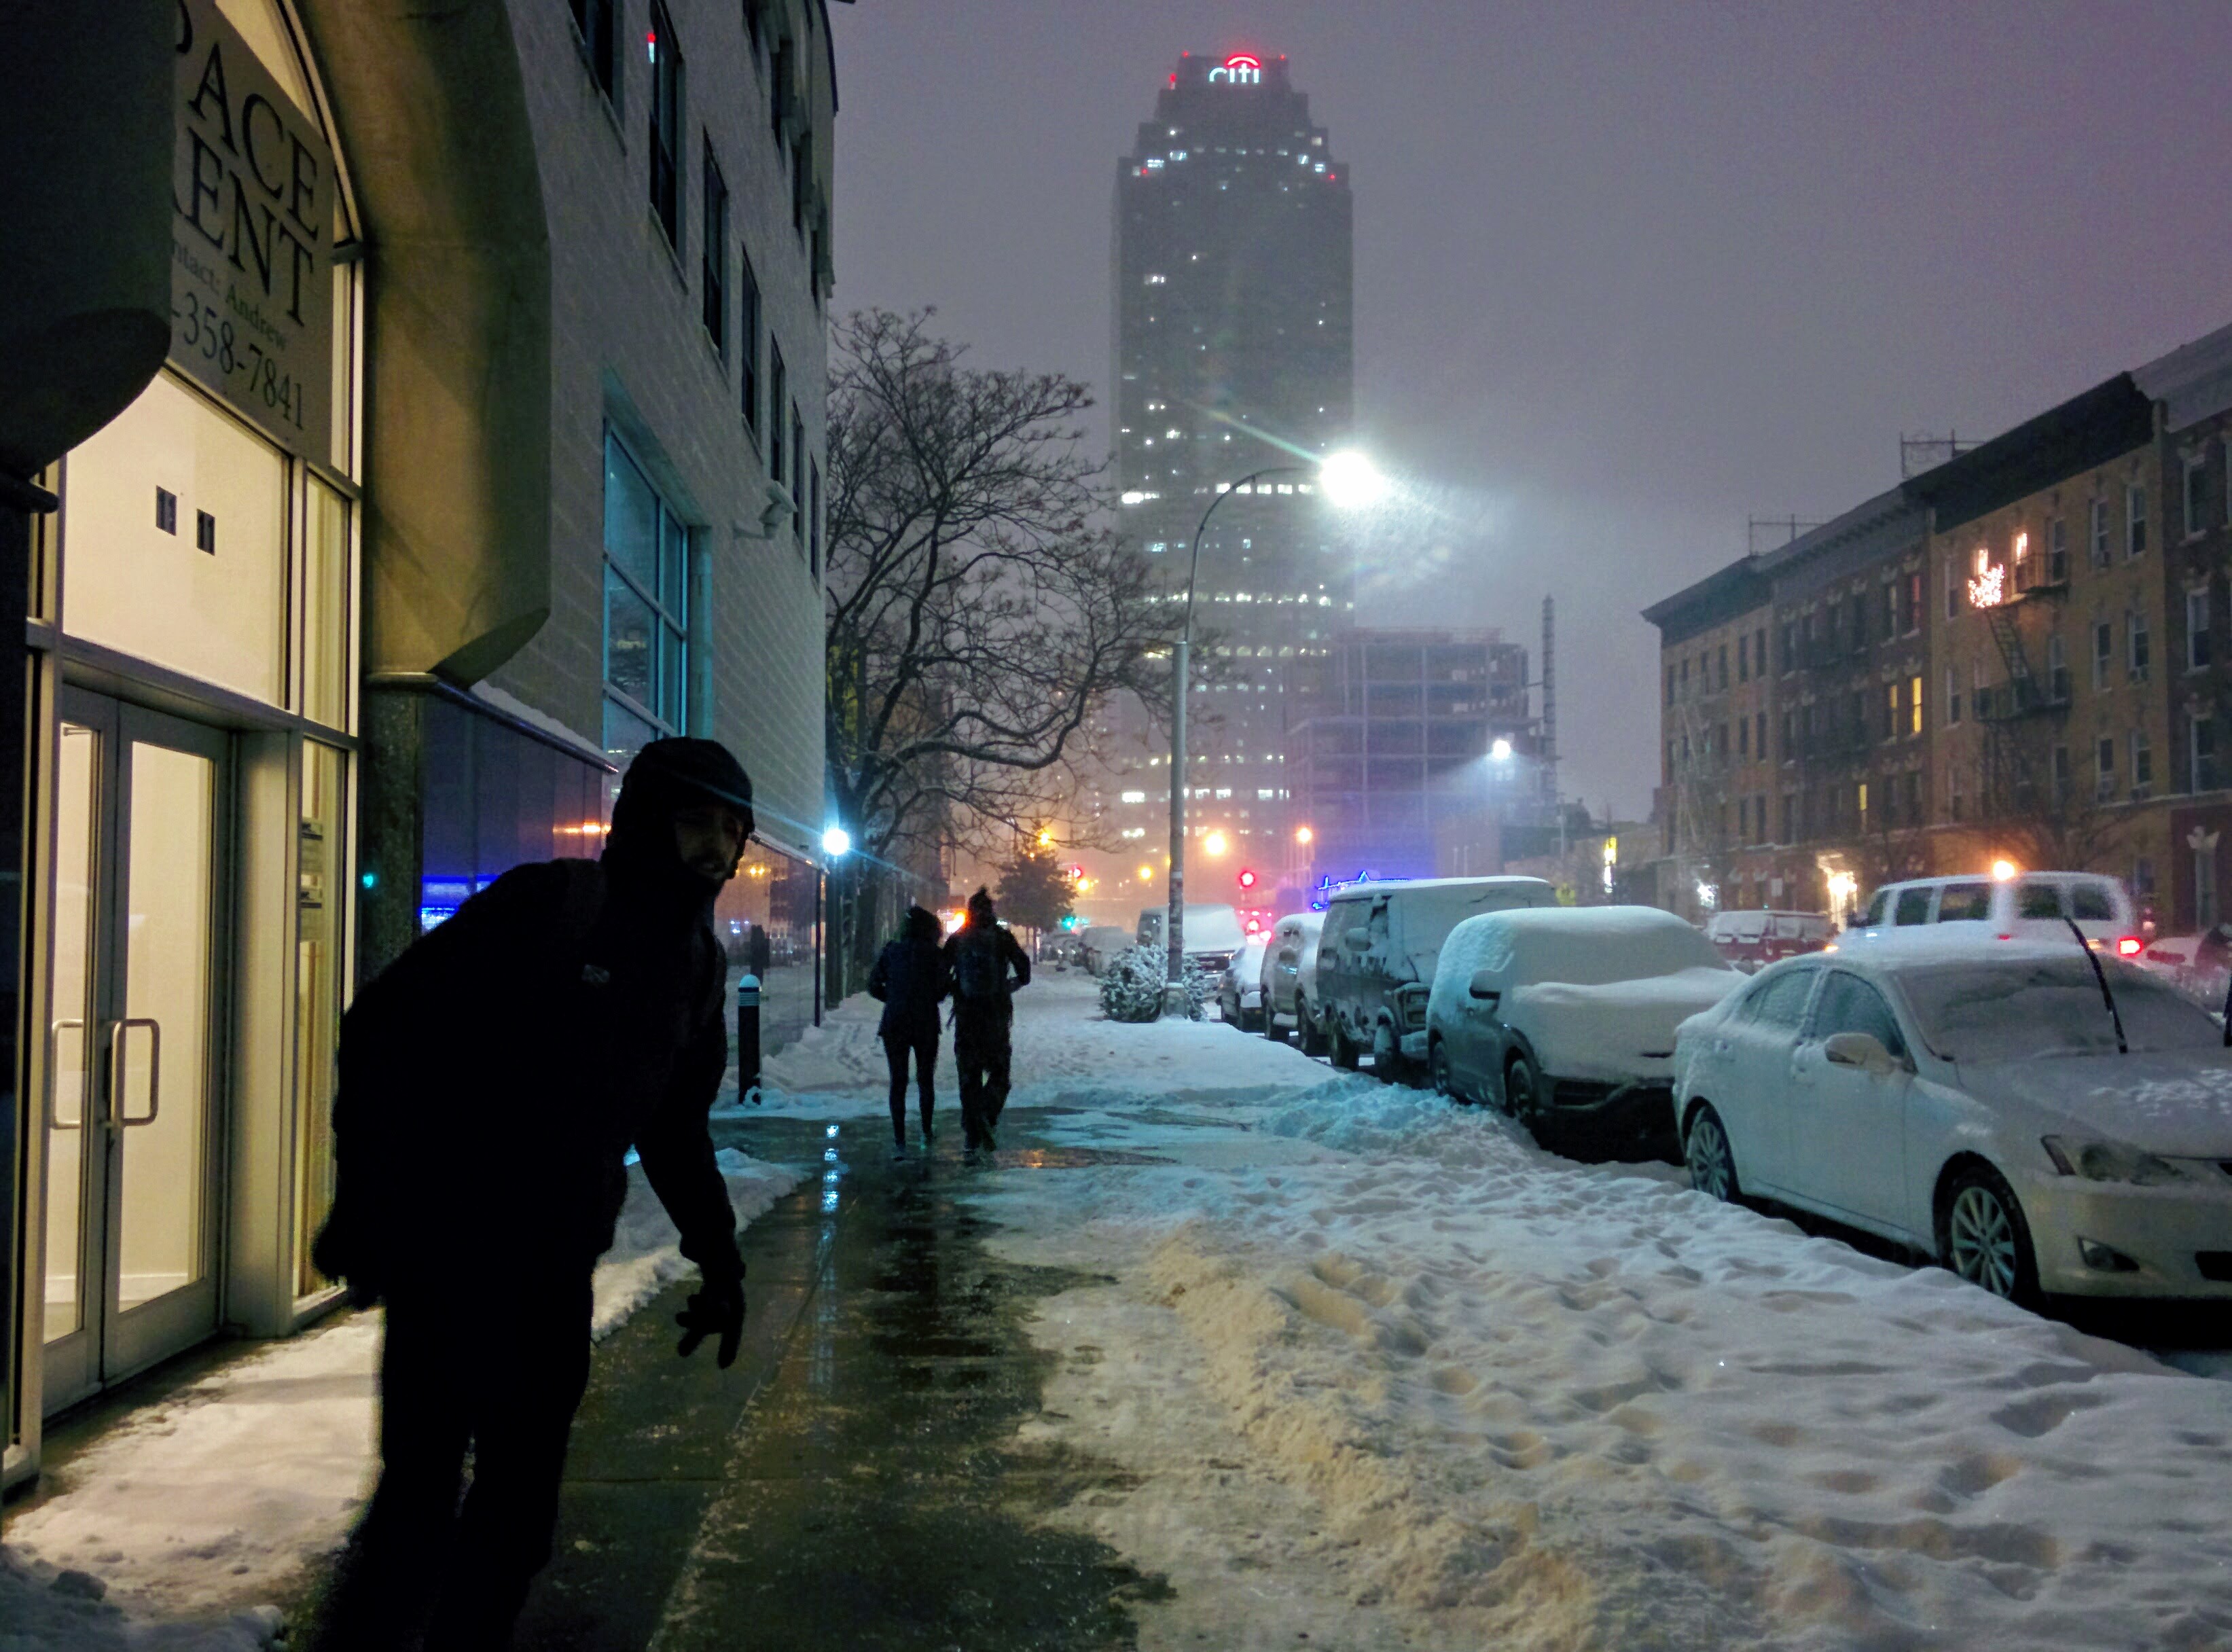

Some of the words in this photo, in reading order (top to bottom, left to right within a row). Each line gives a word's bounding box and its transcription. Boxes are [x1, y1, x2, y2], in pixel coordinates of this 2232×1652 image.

[176, 0, 319, 241] ACE
[175, 126, 314, 327] ENT
[225, 282, 287, 351] Andrew
